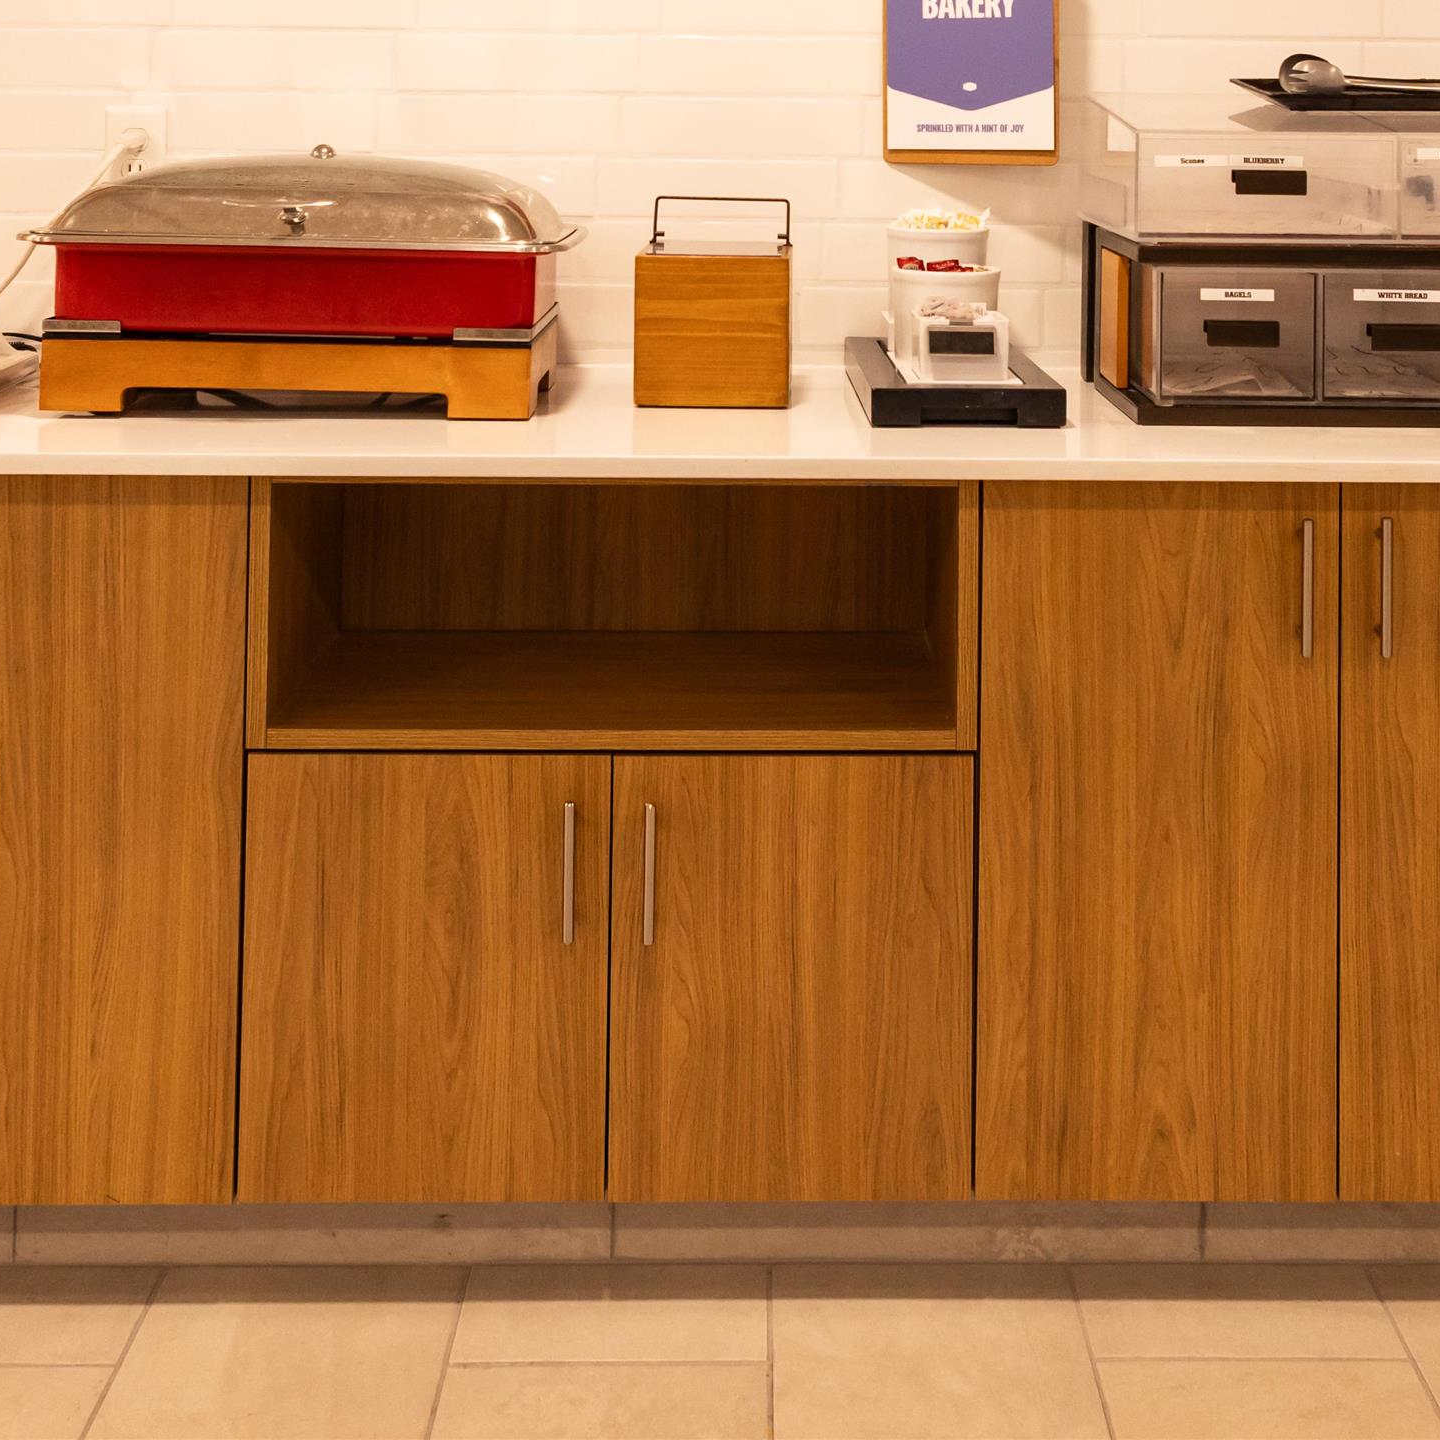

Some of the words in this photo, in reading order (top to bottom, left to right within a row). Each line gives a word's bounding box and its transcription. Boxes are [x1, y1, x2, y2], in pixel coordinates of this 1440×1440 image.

[916, 124, 953, 133] SPRINKLED
[955, 124, 973, 133] WITH
[975, 124, 980, 133] A
[981, 124, 998, 133] HINT
[1000, 124, 1008, 133] OF
[1010, 124, 1025, 133] JOY
[1224, 291, 1252, 299] BAGELS
[1378, 291, 1403, 299] WHITE
[1405, 292, 1428, 300] BREAD
